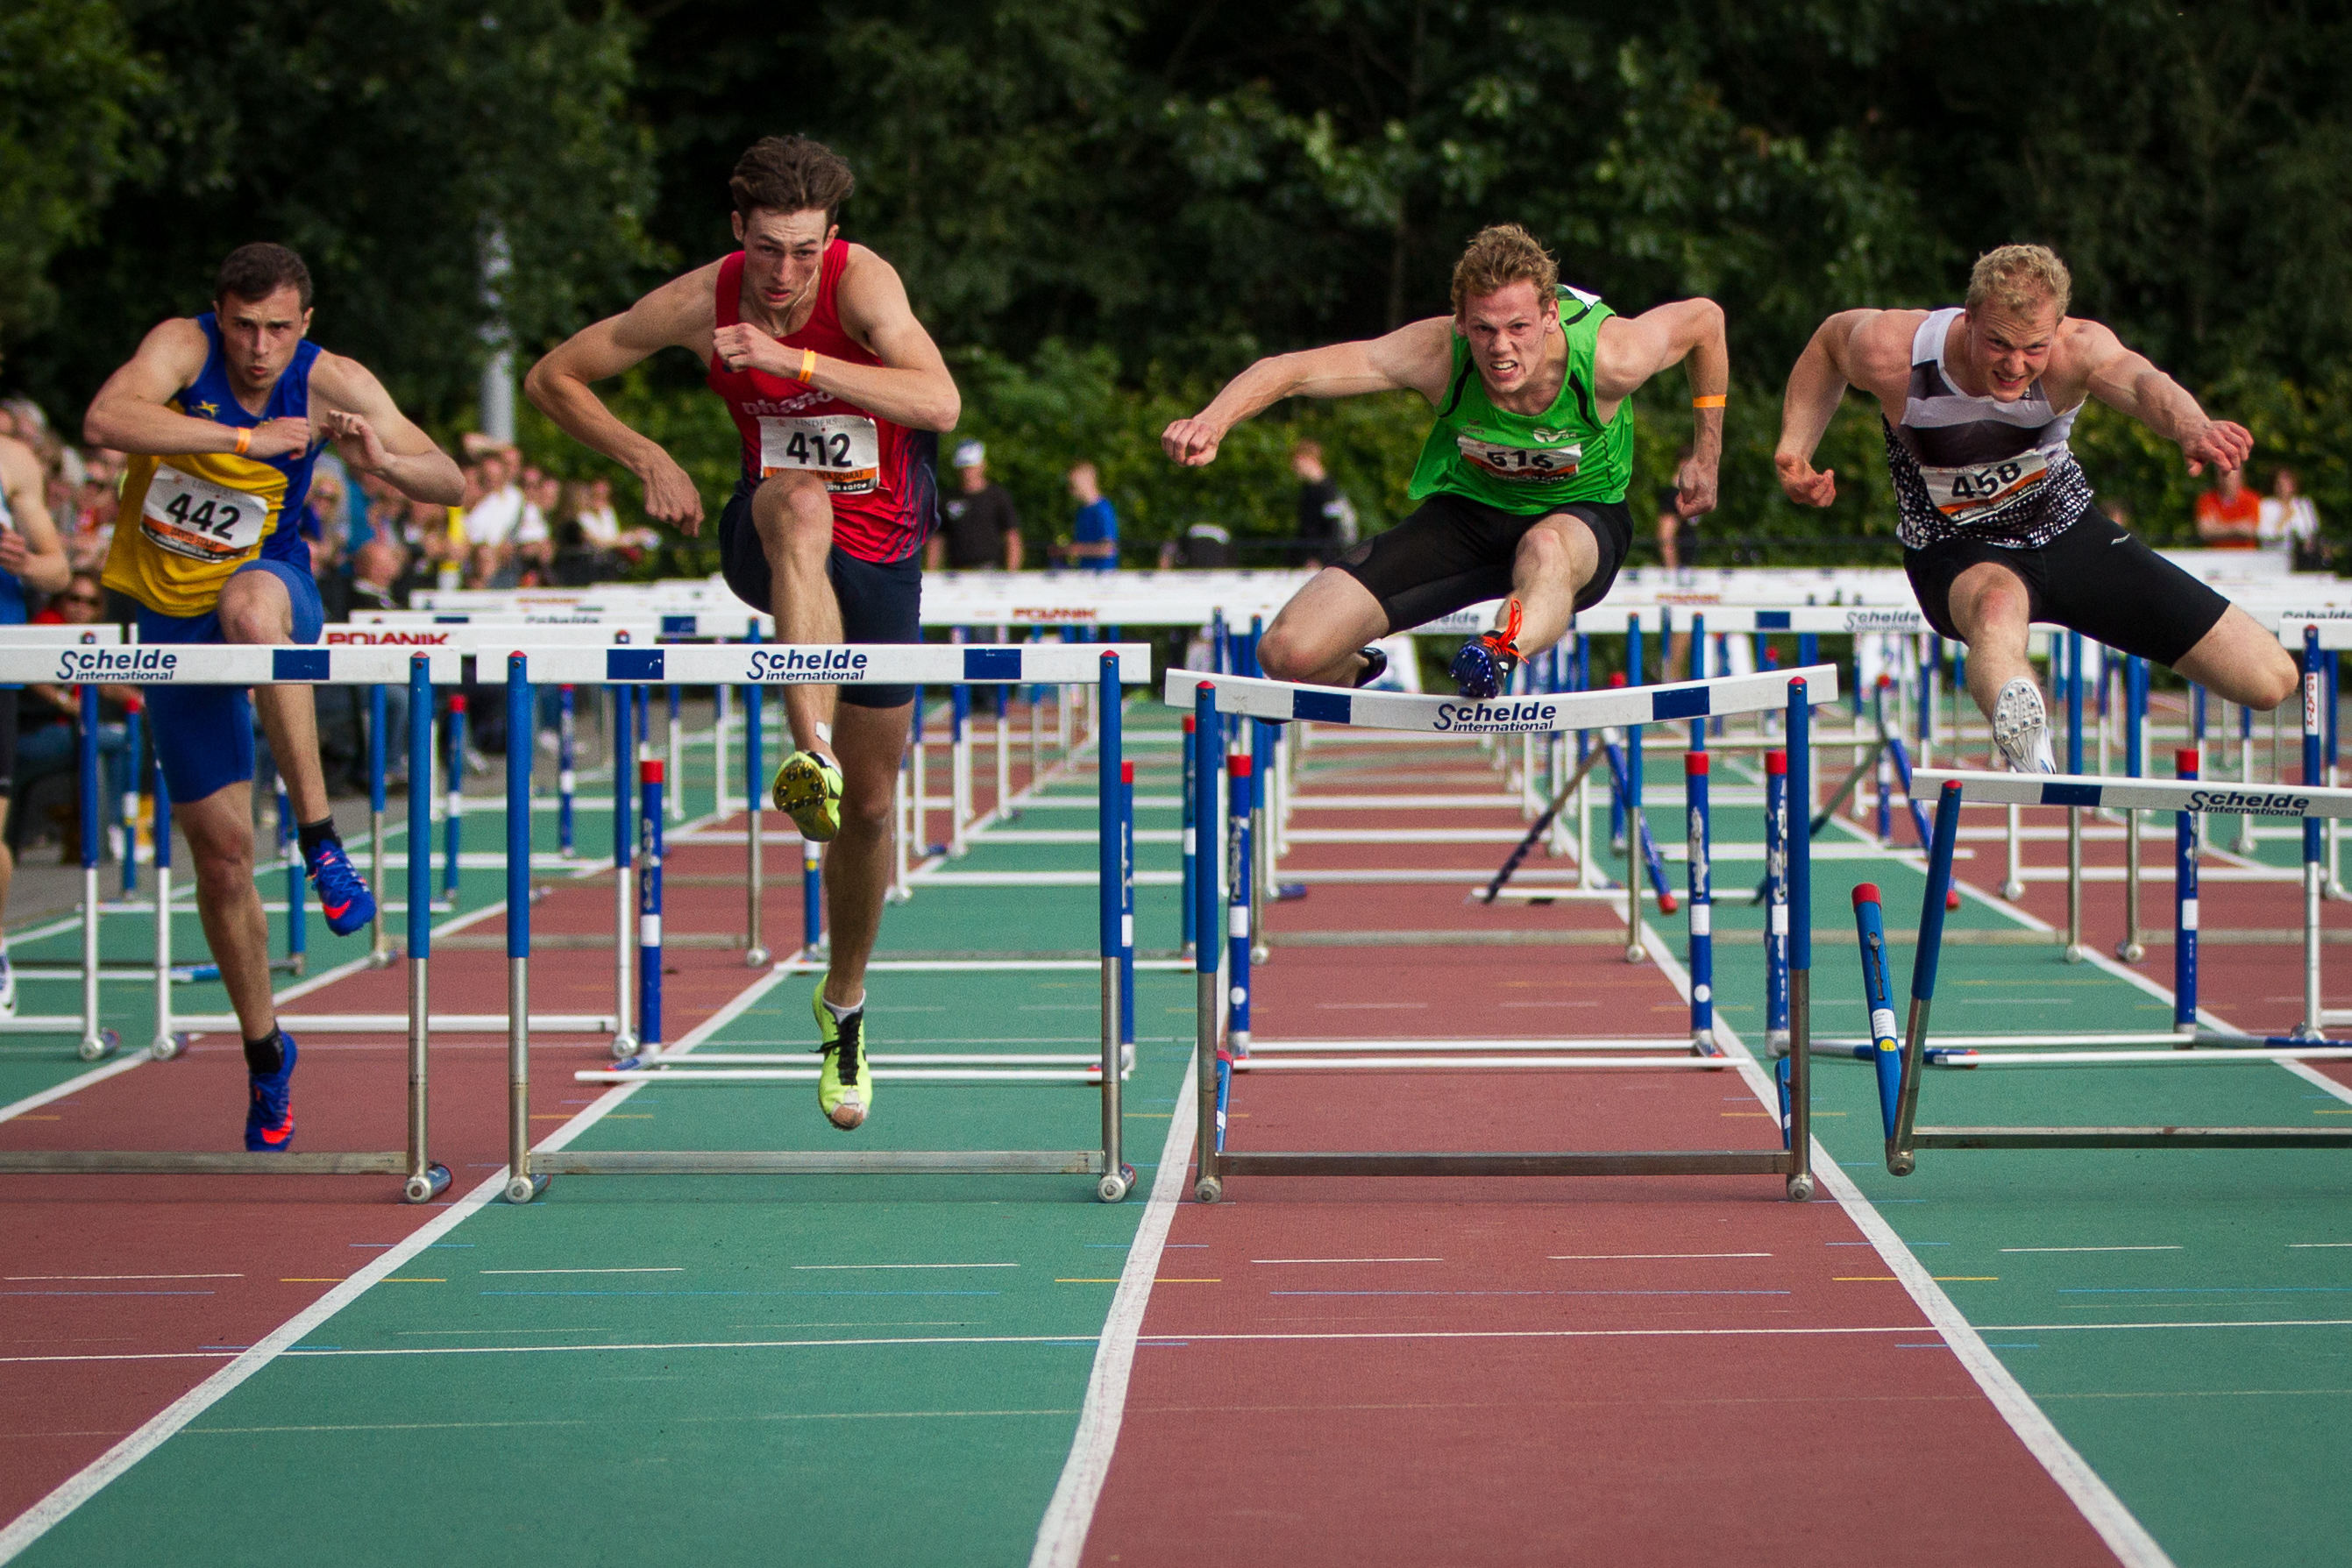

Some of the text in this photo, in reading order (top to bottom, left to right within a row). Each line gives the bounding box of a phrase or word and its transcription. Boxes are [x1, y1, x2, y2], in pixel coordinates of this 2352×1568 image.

[786, 431, 852, 467] 412
[1951, 462, 2022, 499] 458
[166, 493, 240, 541] 442
[1844, 611, 1920, 631] Schelde
[56, 649, 177, 680] Schelde
[75, 670, 174, 680] international
[746, 649, 868, 680] Schelde
[766, 670, 865, 681] international
[1433, 702, 1556, 730] Schelde
[1453, 720, 1553, 732] international
[2185, 791, 2309, 811] Schelde
[2204, 804, 2306, 816] international
